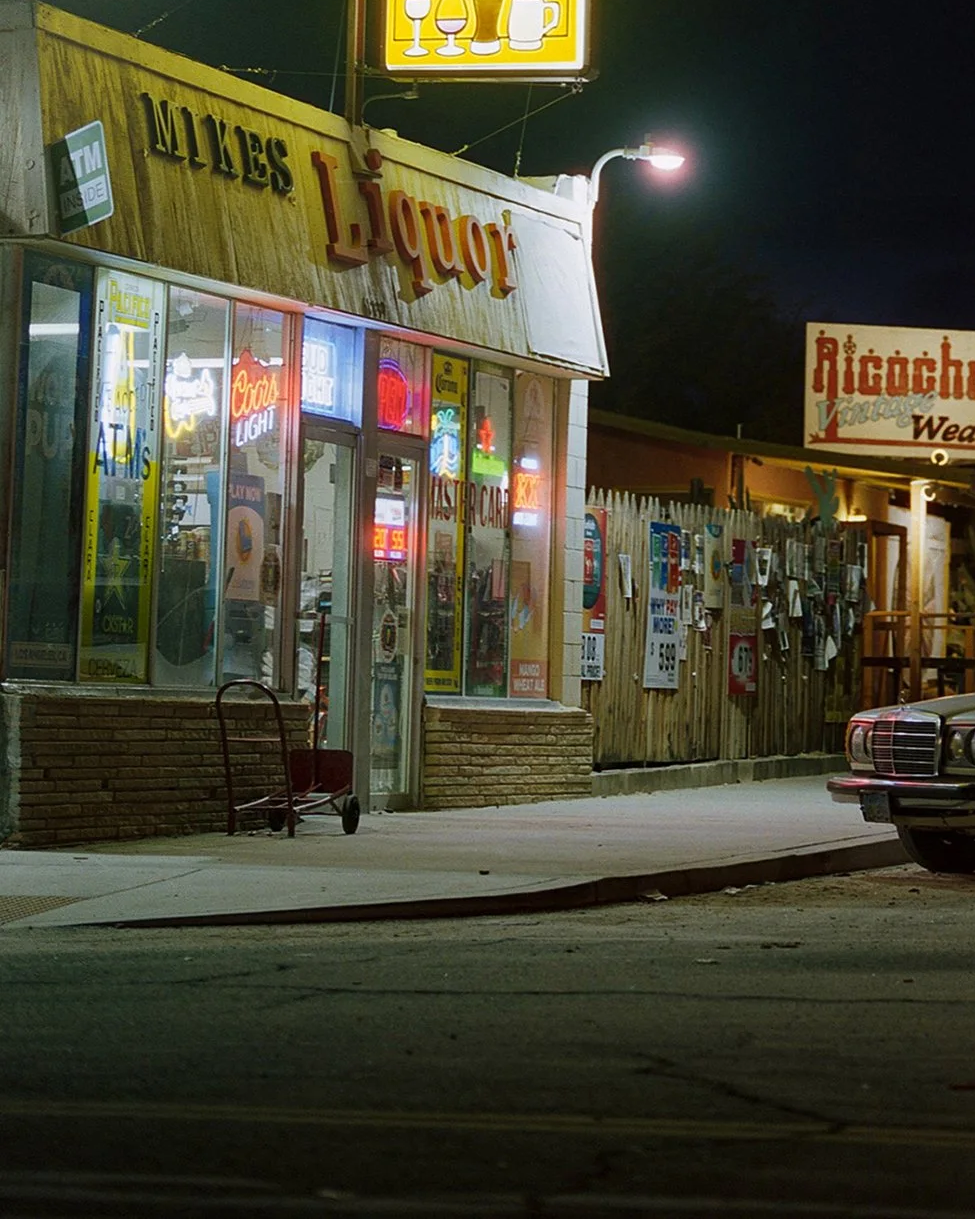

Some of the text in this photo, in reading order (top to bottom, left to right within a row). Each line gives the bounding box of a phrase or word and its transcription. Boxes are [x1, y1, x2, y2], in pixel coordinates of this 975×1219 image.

[59, 140, 103, 189] ATM
[141, 92, 294, 194] MIKES
[63, 181, 104, 214] INSIDE
[311, 148, 517, 300] Liquor
[231, 369, 279, 418] Coors
[815, 390, 938, 432] Vintage
[235, 404, 276, 447] LIGHT
[480, 484, 509, 529] CARD
